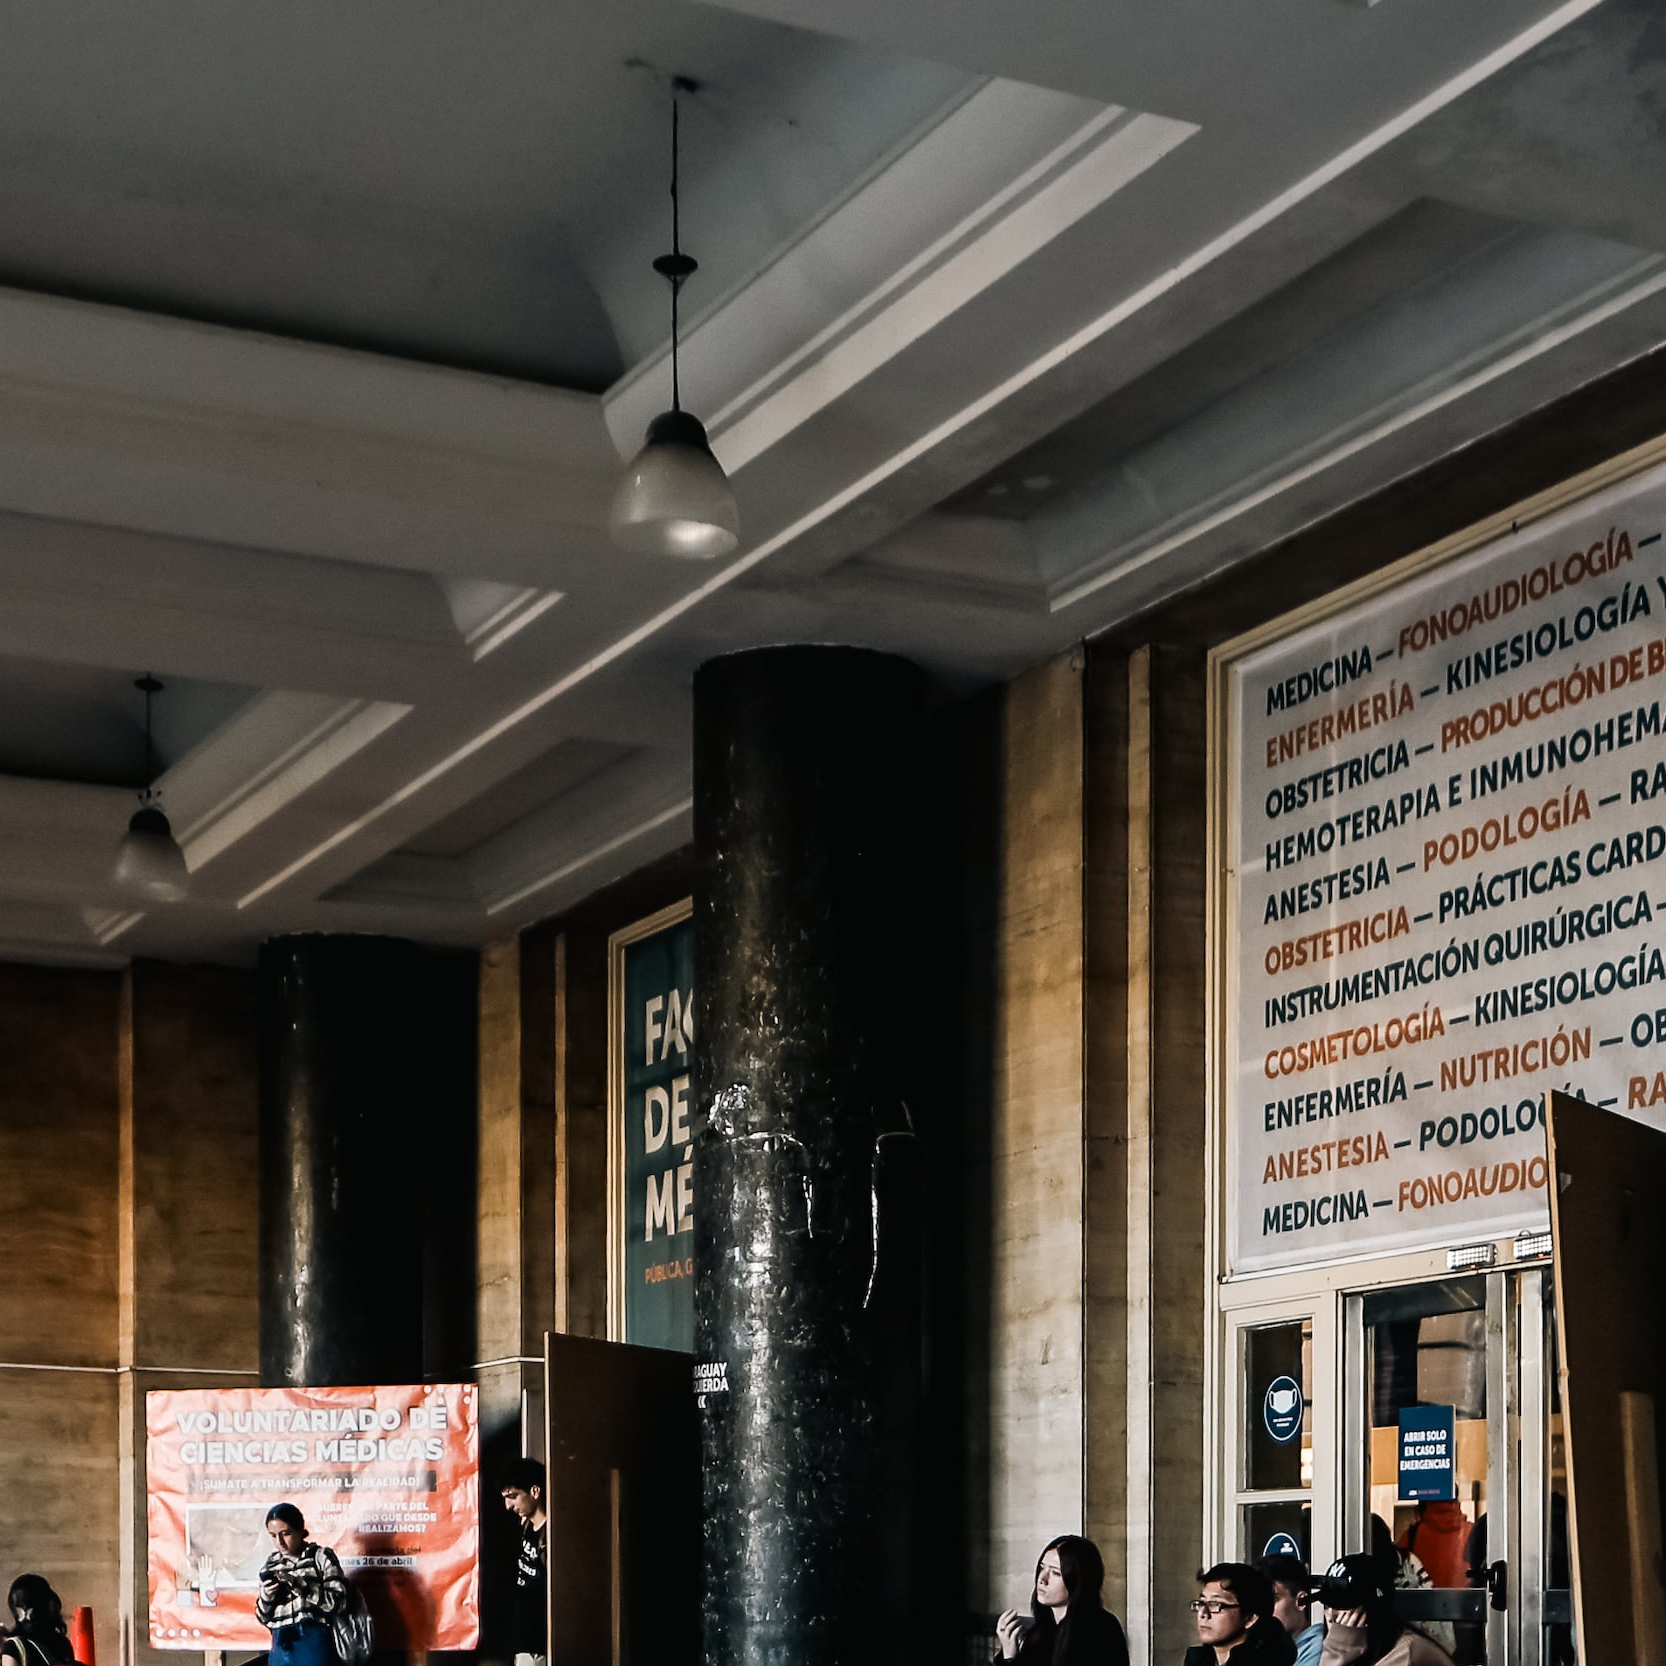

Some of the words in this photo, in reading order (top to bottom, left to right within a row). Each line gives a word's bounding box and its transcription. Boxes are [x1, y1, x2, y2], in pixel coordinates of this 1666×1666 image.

[1267, 645, 1372, 716] MEDICINA
[1398, 526, 1633, 658] FONOAUDIOLOGÍA
[1267, 679, 1414, 768] ENFERMERÍA
[1447, 582, 1651, 695] KINESIOLOGÍA
[1266, 740, 1409, 819] OBSTETRICIA
[1442, 663, 1604, 753] PRODUCCIÓN
[1609, 647, 1644, 689] DE
[1264, 856, 1390, 925] ANESTESIA
[1424, 785, 1591, 872] PODOLOGÍA
[1266, 783, 1440, 872] HEMOTERAPIA
[1448, 774, 1462, 807] E
[1265, 905, 1409, 975] OBSTETRICIA
[1439, 851, 1581, 923] PRÁCTICAS
[1265, 937, 1479, 1029] INSTRUMENTACIÓN
[1483, 891, 1652, 966] QUIRÚRGICA
[1264, 1002, 1445, 1079] COSMETOLOGÍA
[1474, 943, 1666, 1026] KINESIOLOGÍA
[645, 1074, 690, 1154] DE
[1264, 1066, 1407, 1132] ENFERMERÍA
[1440, 1024, 1591, 1091] NUTRICIÓN
[645, 1144, 694, 1242] MÉ
[1263, 1131, 1389, 1184] ANESTESIA
[1263, 1189, 1369, 1236] MEDICINA
[176, 1408, 402, 1434] VOLUNTARIADO
[409, 1406, 448, 1429] DE
[179, 1440, 308, 1464] CIENCIAS
[316, 1433, 444, 1463] MÉDICAS
[1400, 1458, 1451, 1471] EMERGENCIAS
[1404, 1431, 1425, 1443] ABRIR
[1426, 1430, 1447, 1442] SOLO
[1415, 1445, 1436, 1456] CASO
[1436, 1444, 1447, 1455] DE
